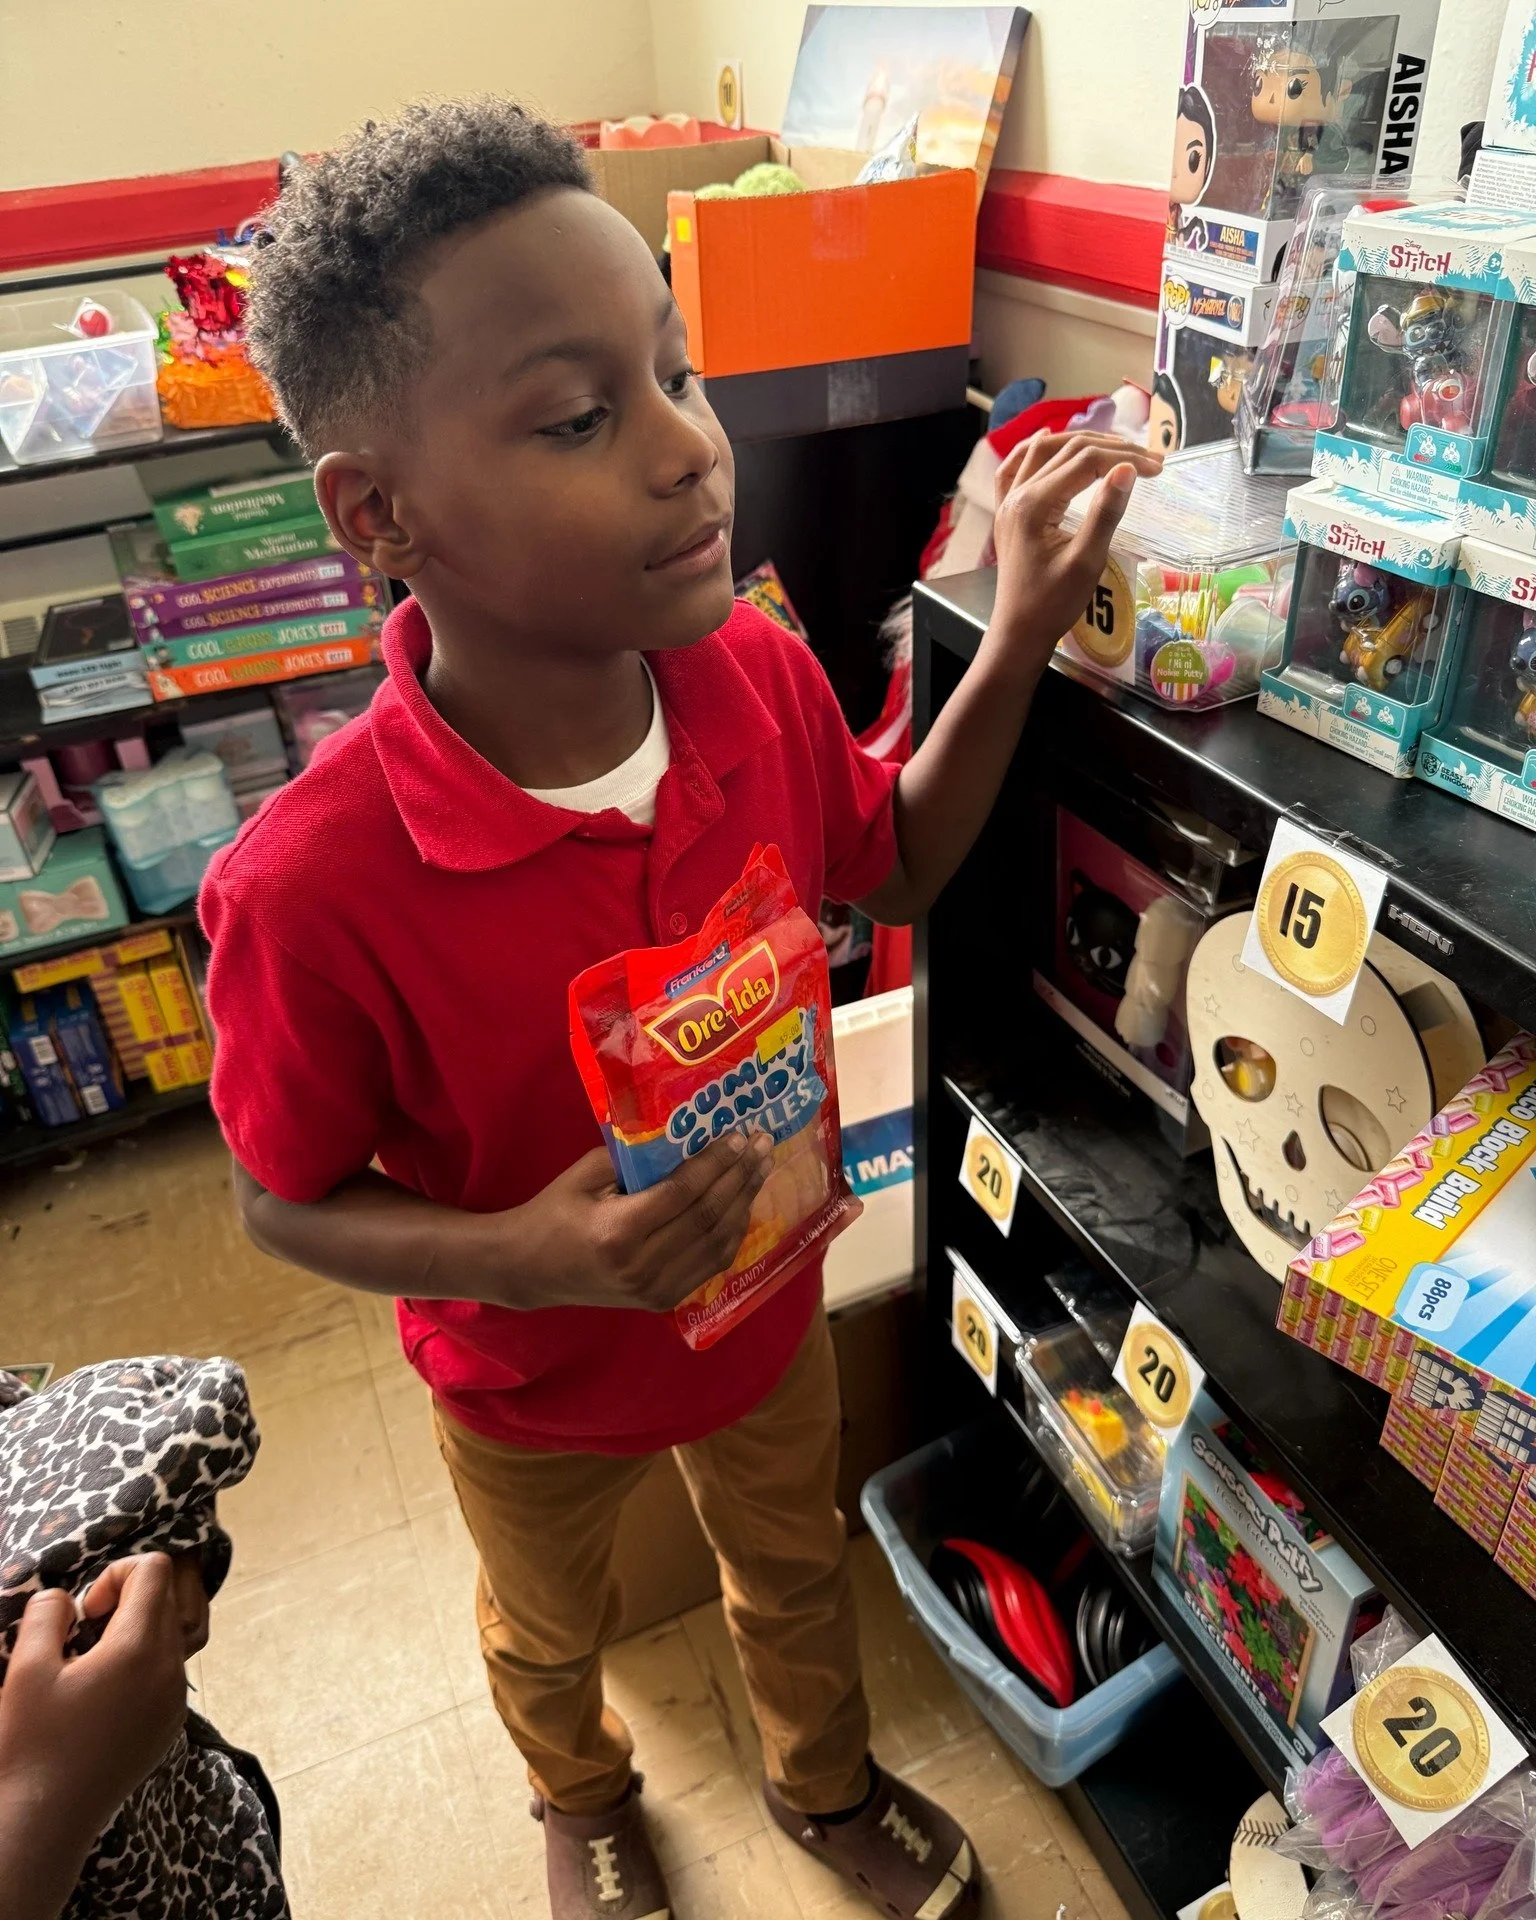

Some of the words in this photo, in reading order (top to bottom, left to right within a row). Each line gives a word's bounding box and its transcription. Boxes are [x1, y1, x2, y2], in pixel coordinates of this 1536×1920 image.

[1378, 52, 1427, 177] AISHA
[1220, 226, 1245, 246] AISHA
[1490, 257, 1500, 267] 3+
[1390, 477, 1411, 491] CHOKING
[1405, 469, 1434, 487] WARNING:
[1420, 553, 1430, 563] 3+
[176, 594, 202, 608] COOL
[201, 578, 257, 603] SCIENCE
[205, 604, 262, 627] SCIENCE
[188, 639, 223, 659] COOL
[277, 624, 318, 644] JOKES
[196, 667, 231, 687] COOL
[284, 652, 325, 670] JOKES
[1183, 667, 1204, 679] Putty
[1330, 726, 1348, 739] CHOKING
[1344, 722, 1371, 741] WARNING:
[1440, 772, 1473, 792] KINGDOM
[1441, 767, 1463, 781] BEAST
[1504, 797, 1527, 813] CHOKING
[1278, 882, 1326, 949] 15
[670, 946, 728, 993] Frankford
[677, 976, 772, 1053] Ore-Ida
[779, 1023, 800, 1045] $5.00
[687, 1045, 806, 1156] CANDY
[1457, 1117, 1530, 1175] Block
[975, 1153, 1004, 1200] 20
[1412, 1169, 1482, 1231] Build
[1367, 1257, 1397, 1282] ONE
[687, 1289, 728, 1326] GUMMY
[731, 1260, 767, 1295] CANDY
[1353, 1277, 1380, 1301] SET
[1418, 1277, 1452, 1321] 88pcs
[964, 1317, 987, 1358] 20
[1137, 1346, 1177, 1404] 20
[1266, 1515, 1324, 1592] Putty
[1184, 1590, 1268, 1706] SUCCULENTS
[1381, 1695, 1464, 1779] 20
